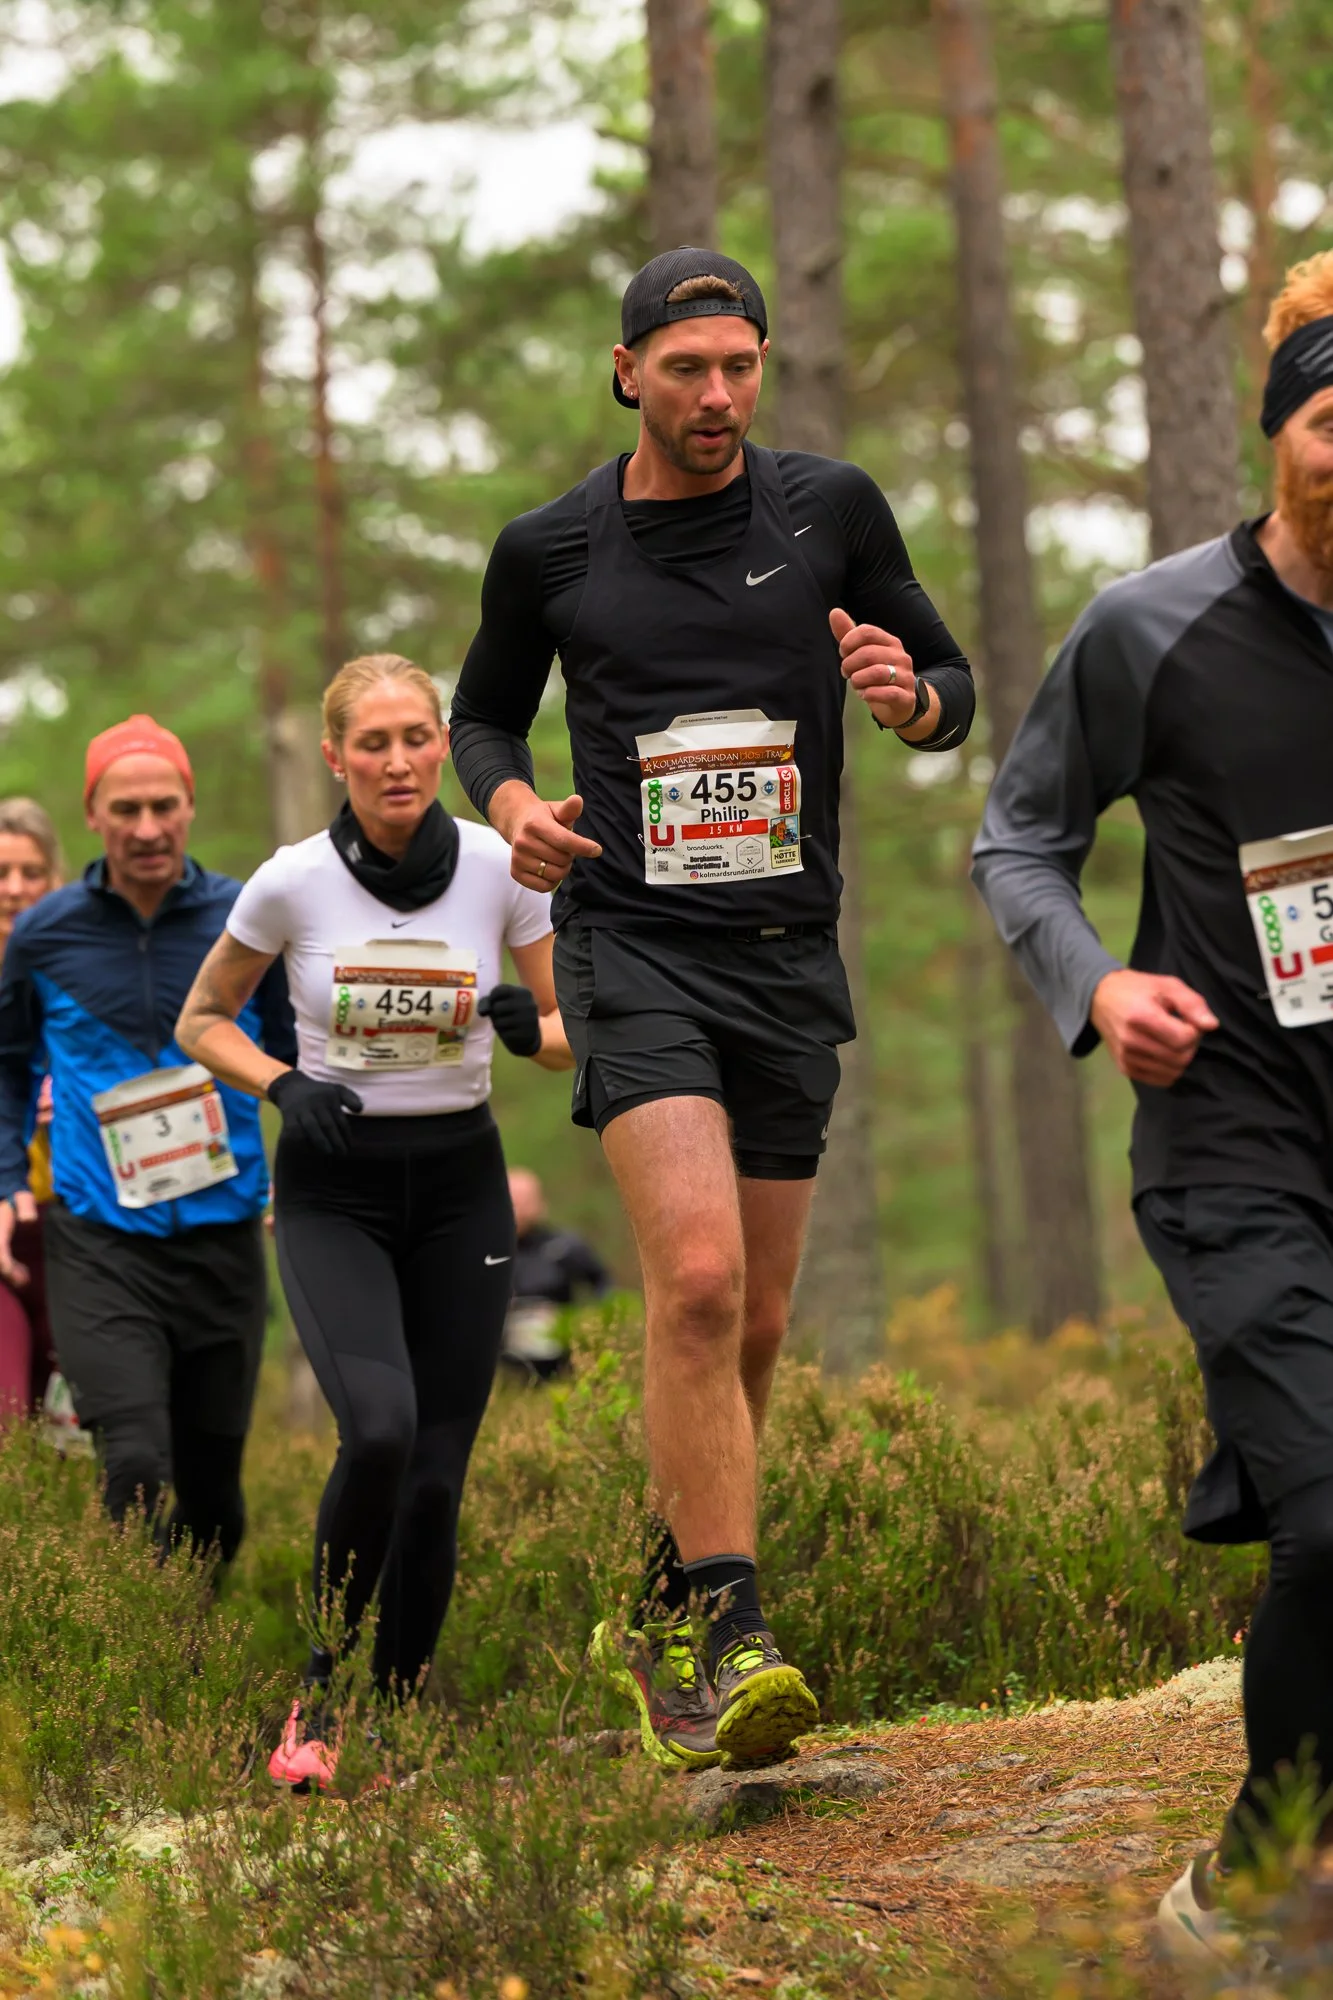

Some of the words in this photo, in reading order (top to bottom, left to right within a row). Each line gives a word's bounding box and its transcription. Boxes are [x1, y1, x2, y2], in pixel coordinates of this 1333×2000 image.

[690, 771, 757, 805] 455
[648, 779, 662, 824] coop
[701, 806, 749, 824] Philip
[709, 825, 722, 835] 15
[729, 823, 743, 834] KM
[774, 850, 797, 860] NØTTE
[699, 867, 765, 879] kolmardsrundantrail
[722, 861, 730, 869] AB
[375, 989, 434, 1016] 454
[154, 1113, 173, 1138] 3
